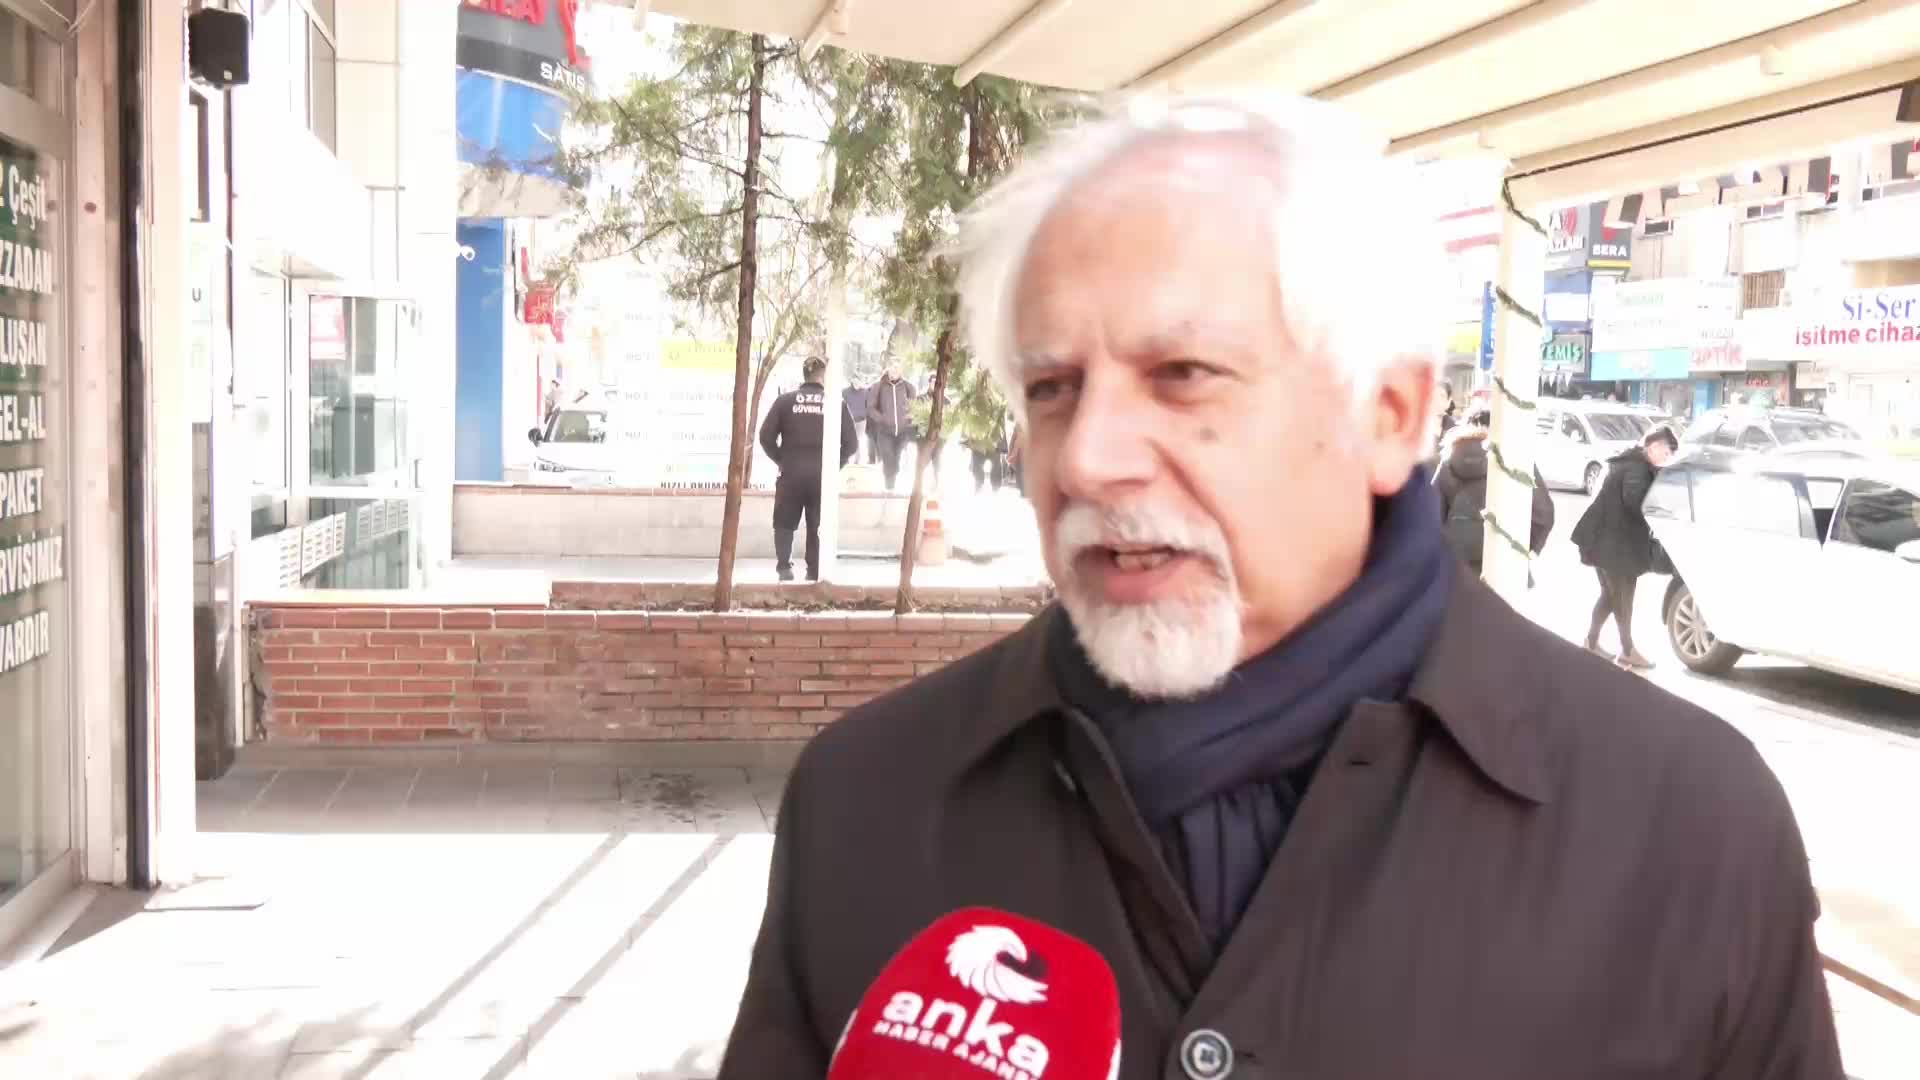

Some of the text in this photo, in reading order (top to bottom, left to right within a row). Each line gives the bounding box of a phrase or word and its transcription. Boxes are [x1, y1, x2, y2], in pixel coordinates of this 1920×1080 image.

[9, 164, 47, 231] Çeşit
[1592, 244, 1627, 257] BERA
[0, 394, 47, 441] EL-AL
[872, 1019, 950, 1052] HABER
[882, 991, 1049, 1080] anka
